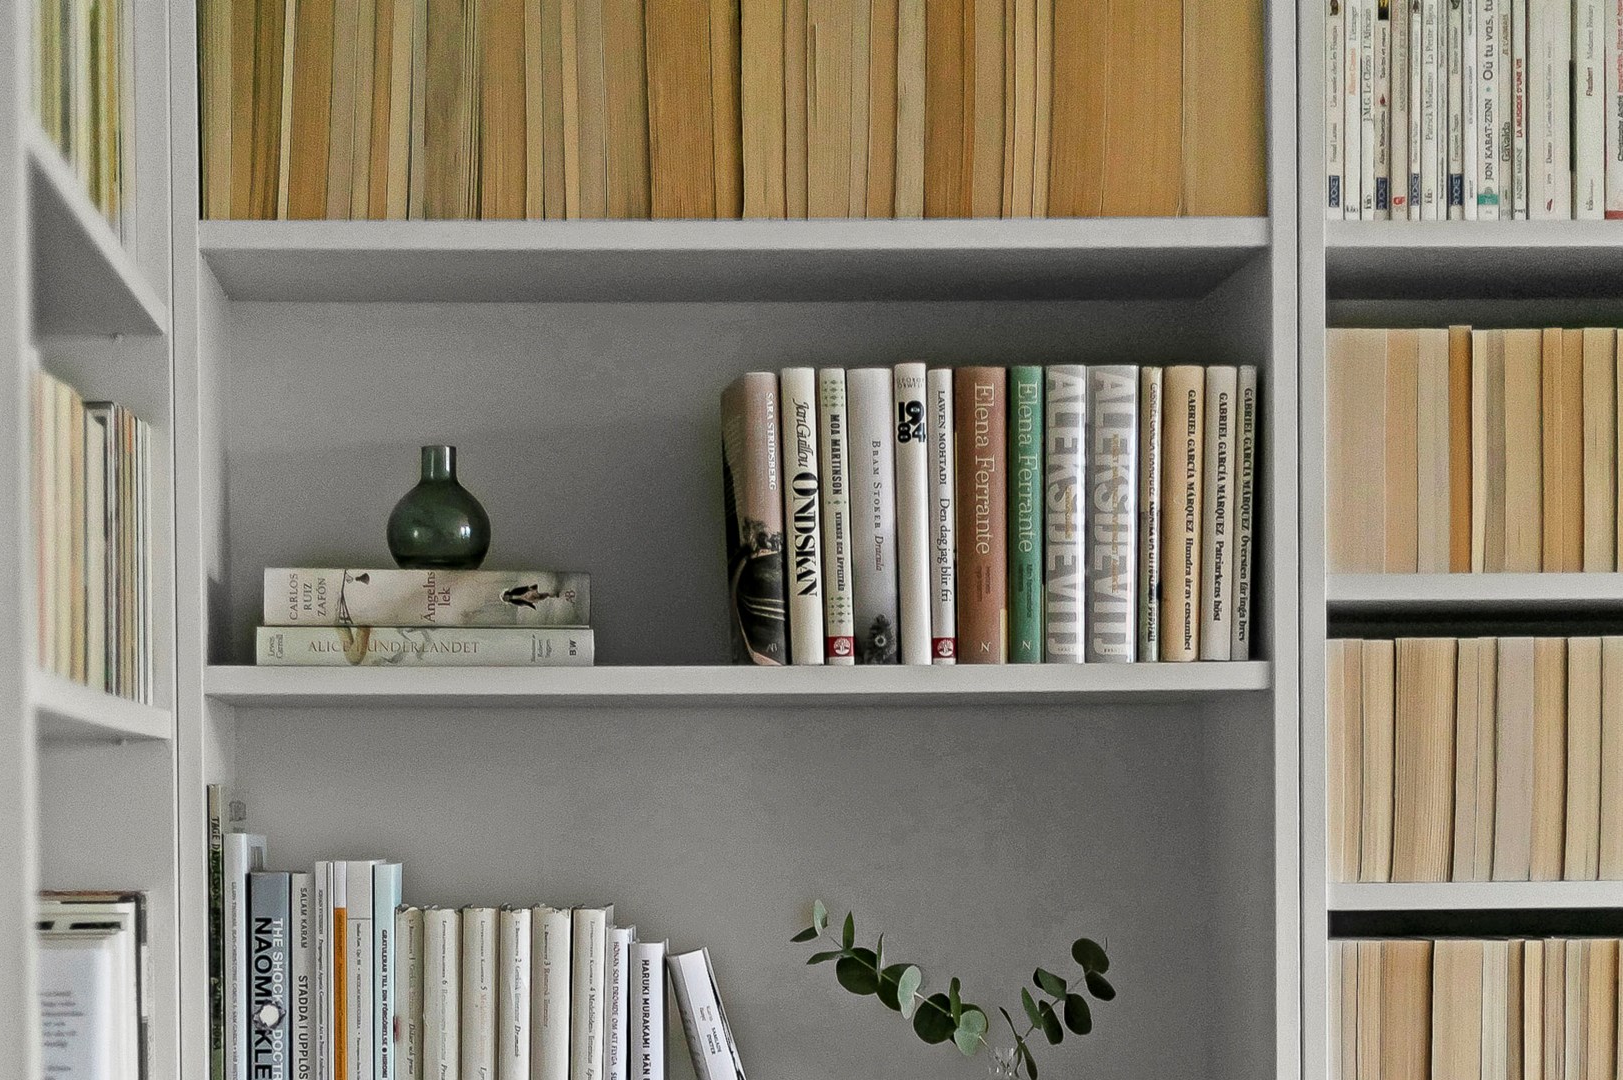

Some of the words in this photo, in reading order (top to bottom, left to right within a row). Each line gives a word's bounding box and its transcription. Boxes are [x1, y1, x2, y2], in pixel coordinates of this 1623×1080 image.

[1485, 44, 1493, 58] tu
[1485, 99, 1493, 160] KABAT-ZINN
[1485, 162, 1493, 180] JON
[765, 392, 775, 420] SARA
[937, 390, 947, 428] LAWEN
[975, 382, 995, 449] Elena
[1017, 380, 1039, 446] Elena
[1187, 390, 1197, 436] GABRIEL
[1218, 392, 1229, 440] GABRIEL
[1243, 388, 1253, 435] GABRIEL
[830, 414, 841, 436] MOA
[767, 422, 777, 490] STRIDSBERG
[831, 439, 843, 495] MARTINSON
[871, 440, 881, 476] BRAM
[939, 432, 947, 485] MOHTADI
[1187, 440, 1198, 479] GARCÍA
[1217, 442, 1229, 482] GARCÍA
[873, 482, 883, 528] STOKER
[939, 498, 951, 522] Den
[975, 454, 995, 554] Ferrante
[1018, 453, 1038, 553] Ferrante
[1185, 482, 1197, 532] MÁRQUEZ
[1215, 484, 1227, 536] MÁRQUEZ
[792, 472, 819, 598] ONDSKAN
[937, 525, 951, 546] dag
[873, 536, 885, 572] Dracula
[936, 546, 951, 564] jag
[1185, 538, 1194, 576] Hundra
[1213, 540, 1225, 598] Patriarkens
[939, 566, 952, 588] blir
[940, 588, 952, 602] fri
[289, 573, 299, 620] CARLOS
[303, 582, 313, 610] RUIZ
[315, 578, 327, 616] ZAFÓN
[420, 572, 439, 622] Ängelns
[437, 587, 451, 606] lek
[1213, 600, 1224, 622] höst
[1237, 596, 1248, 618] inga
[1184, 602, 1193, 651] ensamhet
[1238, 620, 1248, 642] brev
[309, 640, 351, 652] ALICE
[367, 640, 480, 654] UNDERLANDET
[211, 816, 221, 840] TAGE
[299, 887, 309, 916] SALAM
[273, 918, 283, 948] THE
[299, 918, 309, 949] KARAM
[641, 959, 650, 995] HARUKI
[297, 974, 309, 1022] STADDA
[611, 1018, 619, 1030] OM
[611, 1032, 619, 1044] ATT
[641, 997, 651, 1048] MURAKAMI
[611, 1044, 619, 1066] FLYGA
[642, 1053, 651, 1075] MÄN
